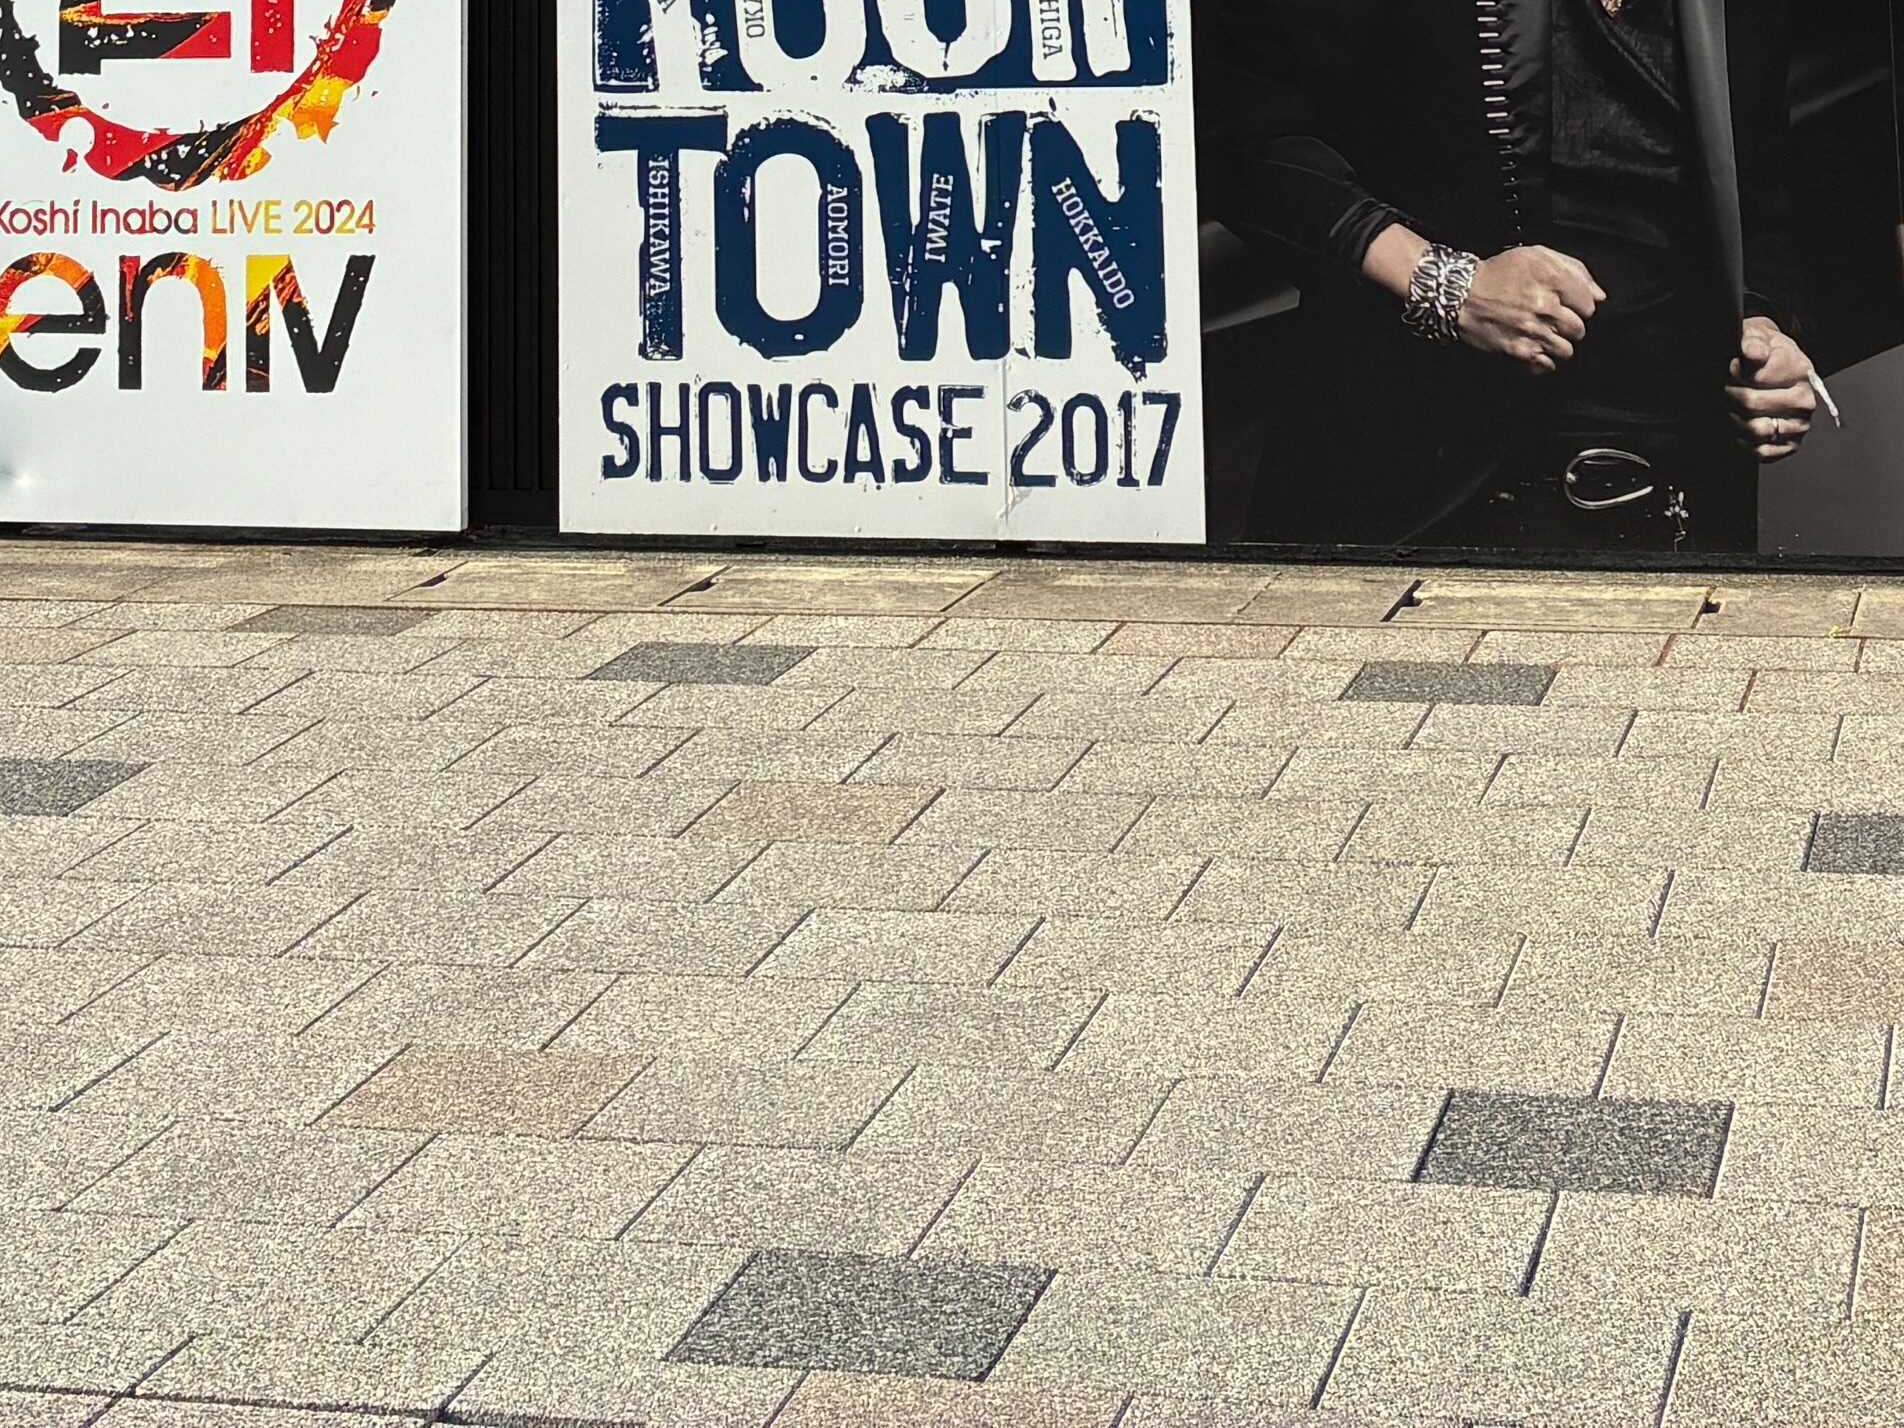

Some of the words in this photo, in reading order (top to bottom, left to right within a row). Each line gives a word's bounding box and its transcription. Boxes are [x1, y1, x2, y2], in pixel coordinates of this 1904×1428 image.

[92, 199, 199, 235] Inaba
[211, 199, 282, 234] LIVE
[293, 199, 377, 235] 2024
[596, 109, 1167, 361] TOWN
[647, 159, 672, 298] ISHIKAWA
[827, 183, 851, 288] AOMORI
[924, 173, 954, 263] IWATE
[1051, 177, 1136, 311] HOKKAIDO
[600, 381, 990, 486] SHOWCASE
[1007, 388, 1182, 489] 2017
